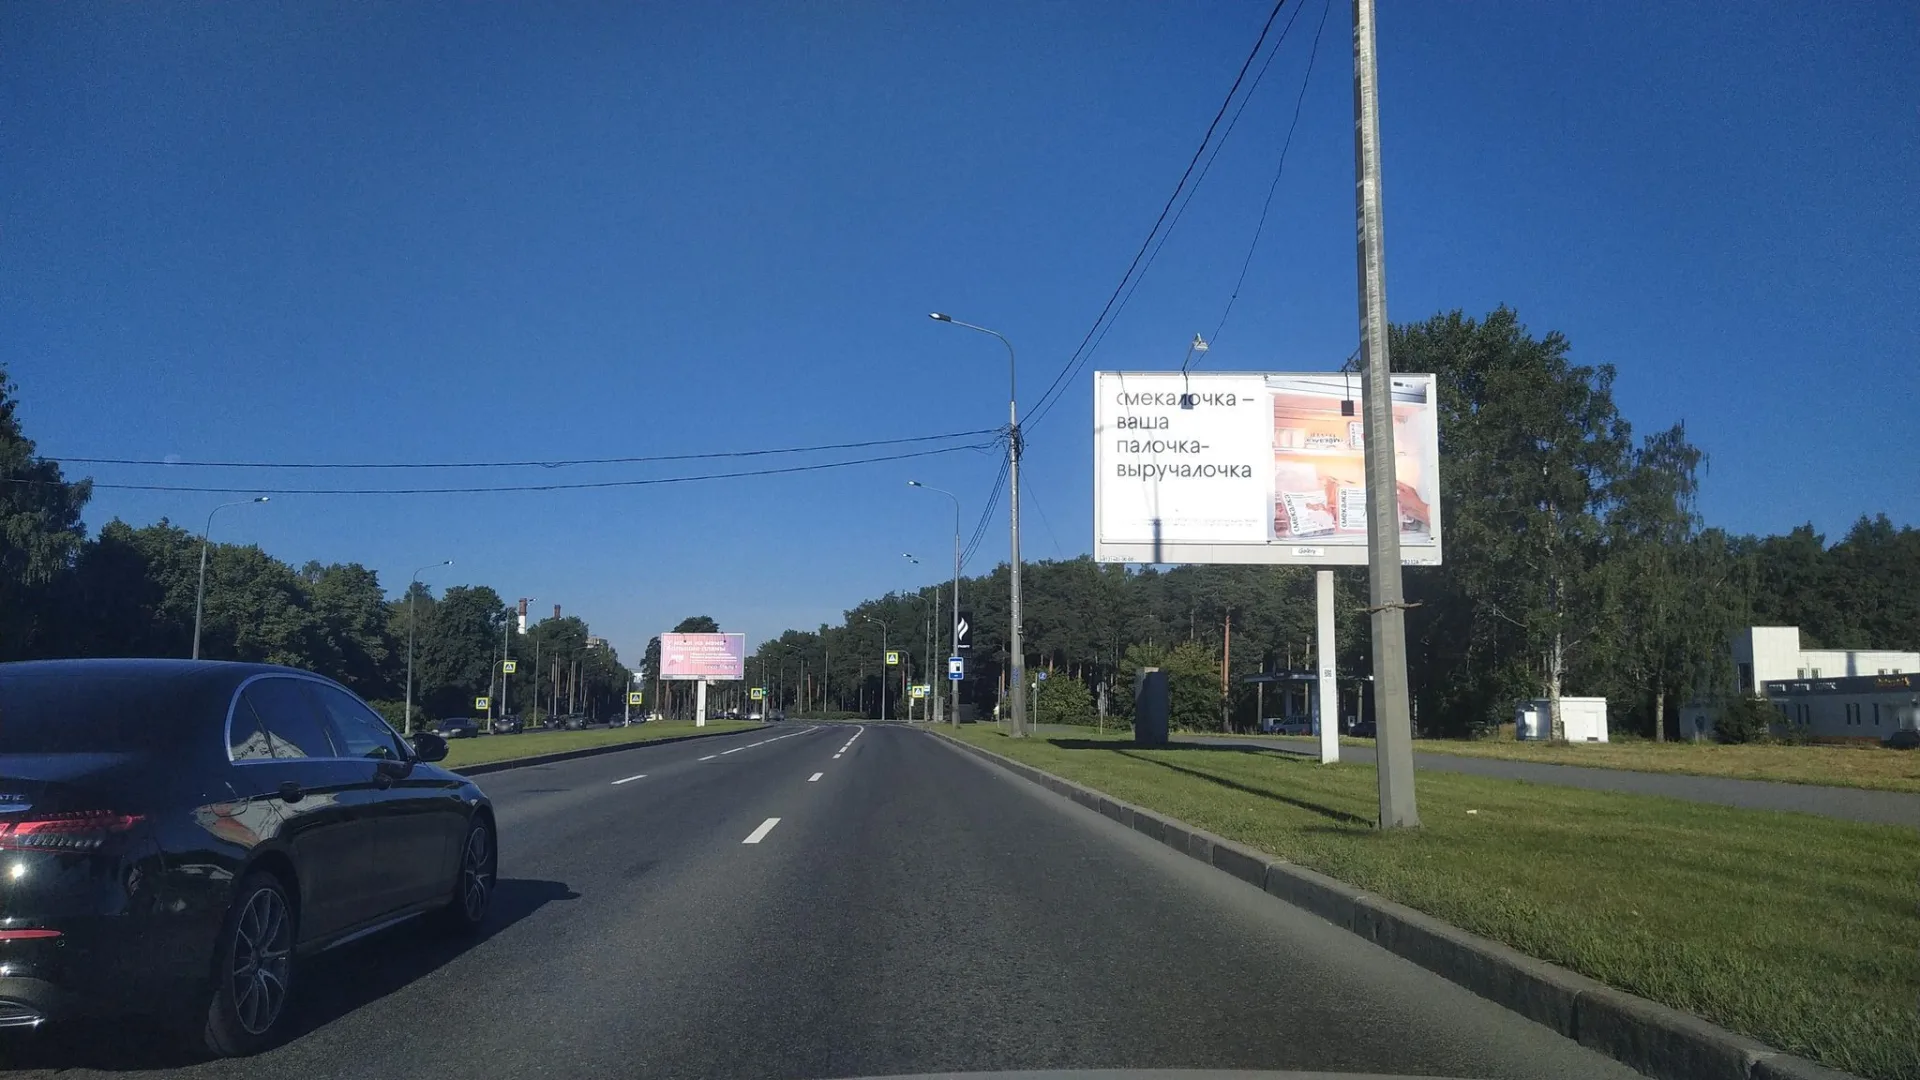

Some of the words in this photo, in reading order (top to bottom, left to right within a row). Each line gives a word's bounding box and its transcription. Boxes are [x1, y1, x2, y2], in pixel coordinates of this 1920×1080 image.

[1116, 392, 1237, 406] смекалочка
[1116, 416, 1169, 430] ваша
[1116, 463, 1252, 482] выручалочка
